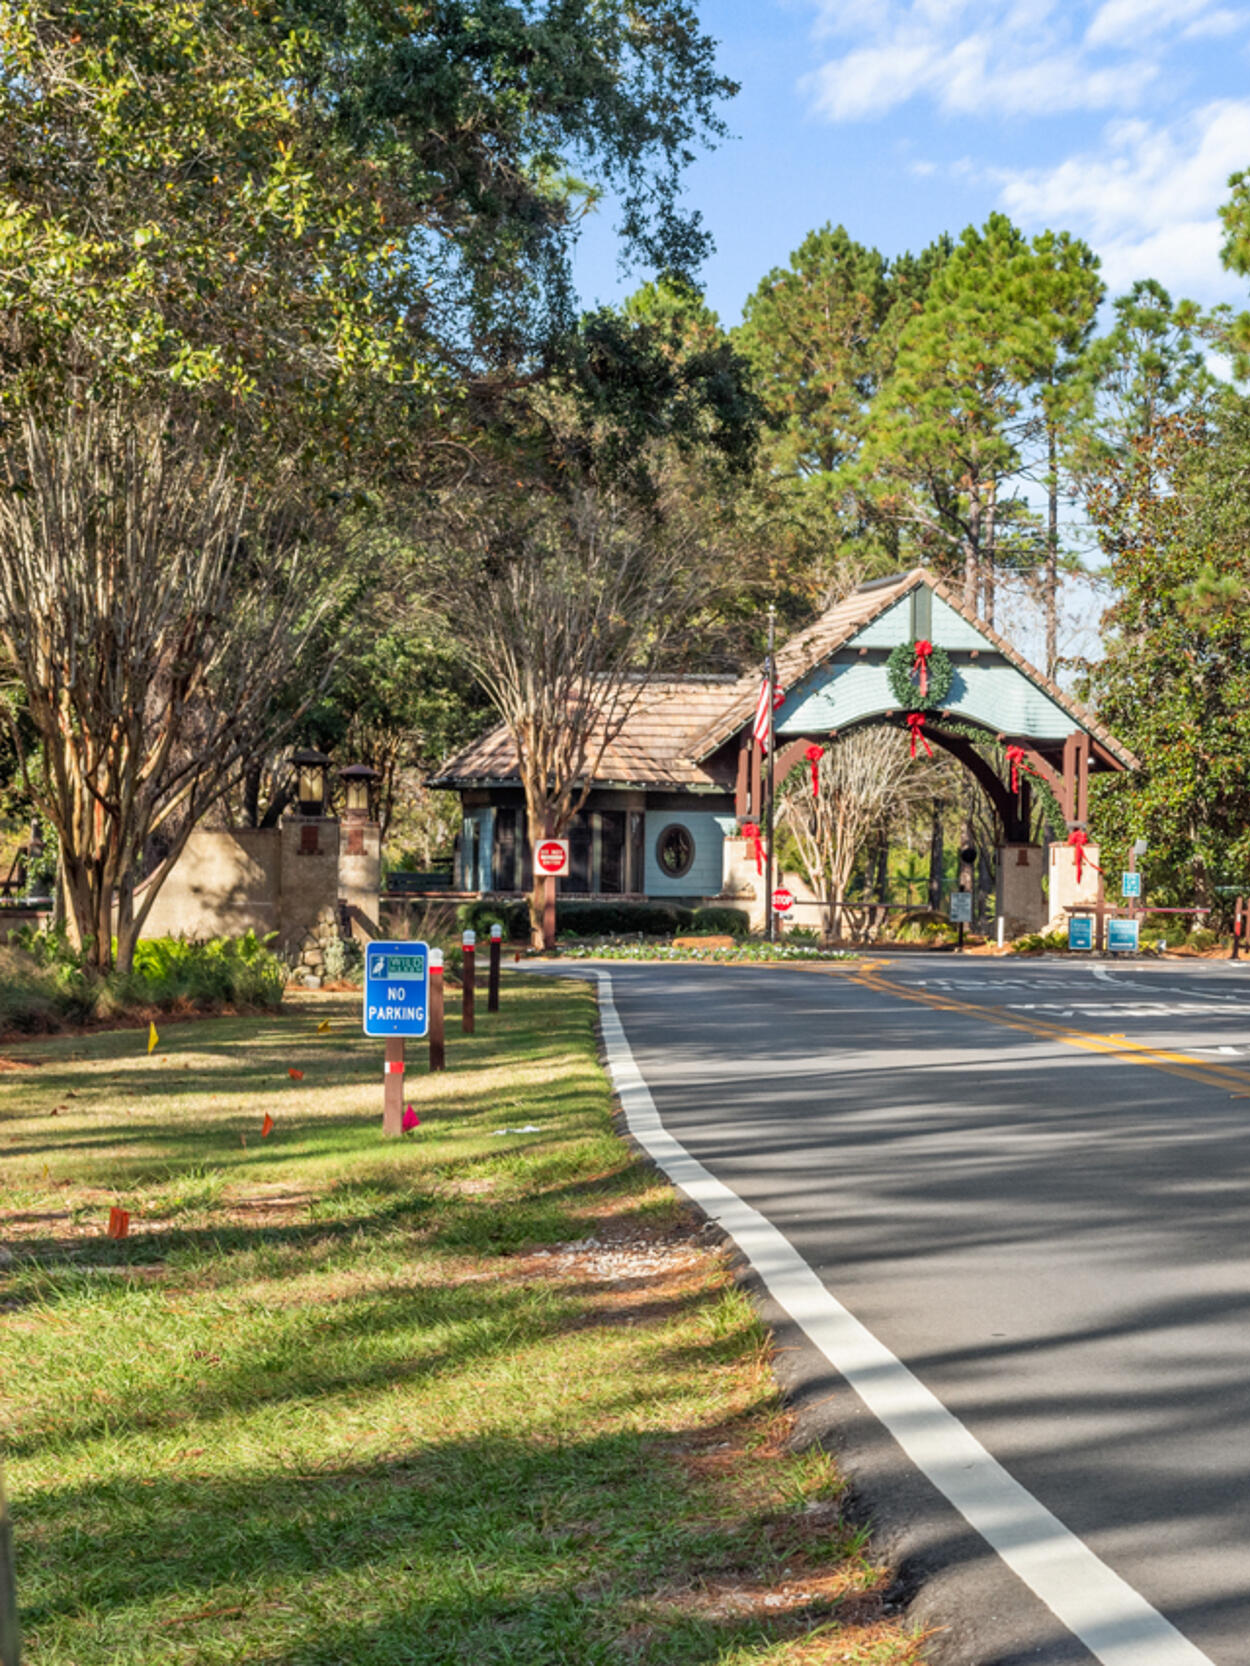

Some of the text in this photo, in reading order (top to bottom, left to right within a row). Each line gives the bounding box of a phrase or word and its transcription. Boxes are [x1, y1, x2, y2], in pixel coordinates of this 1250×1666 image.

[771, 895, 793, 905] STOP
[387, 987, 406, 1001] NO
[368, 1006, 424, 1021] PARKING
